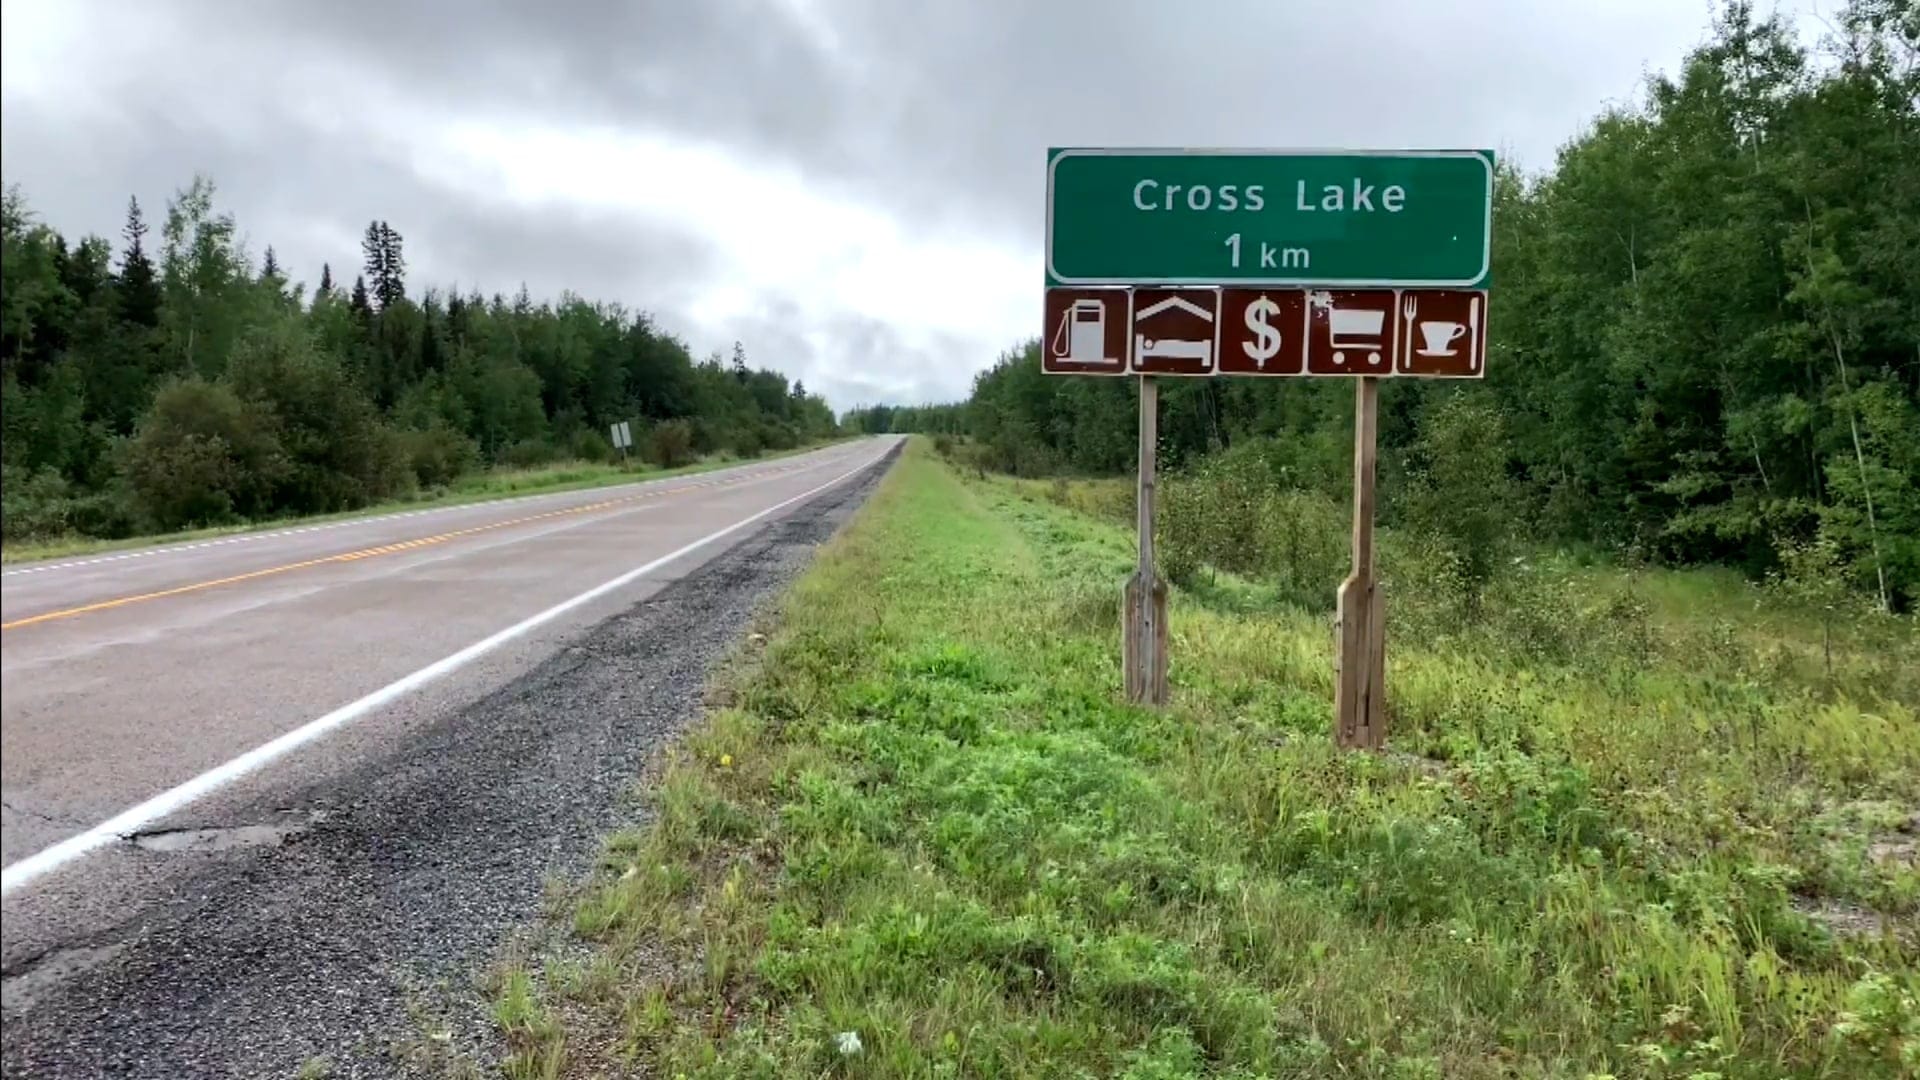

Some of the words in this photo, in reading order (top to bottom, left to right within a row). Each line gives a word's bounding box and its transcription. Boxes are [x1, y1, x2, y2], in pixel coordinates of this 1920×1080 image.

[1133, 179, 1265, 211] Cross
[1297, 178, 1405, 212] Lake
[1225, 233, 1241, 267] 1
[1261, 242, 1310, 268] km
